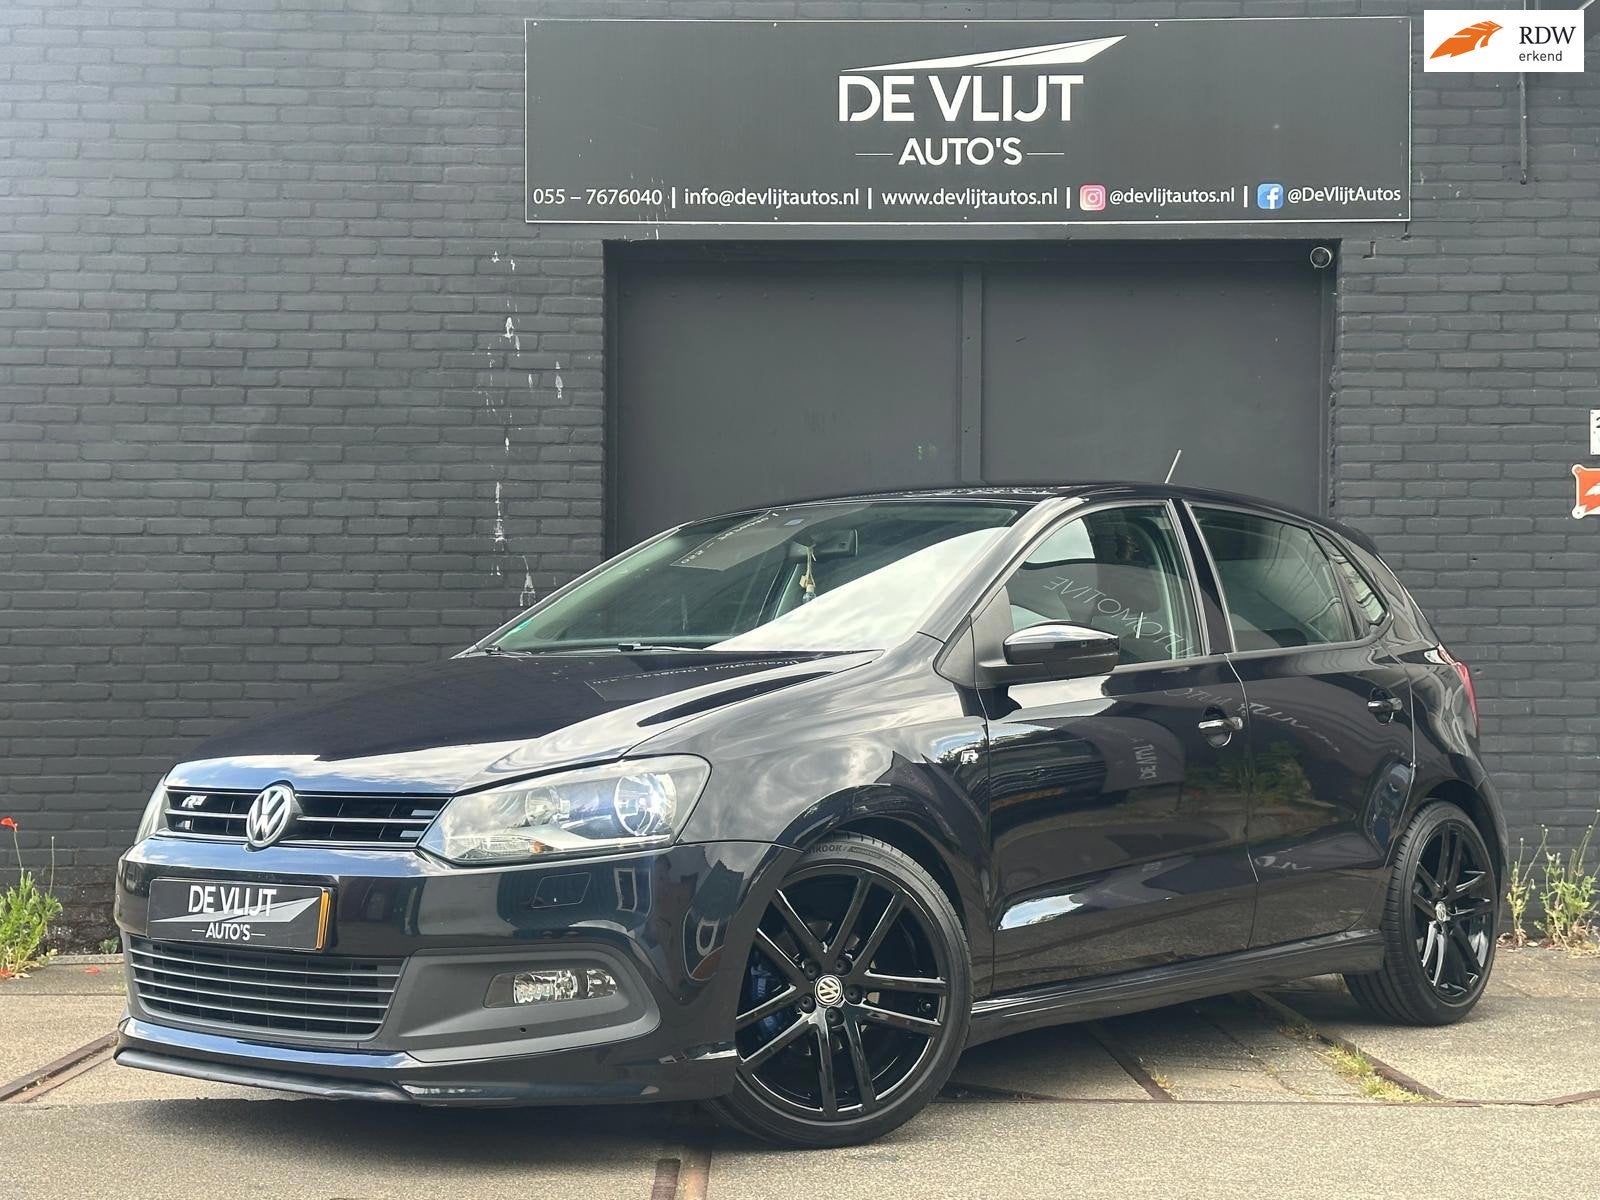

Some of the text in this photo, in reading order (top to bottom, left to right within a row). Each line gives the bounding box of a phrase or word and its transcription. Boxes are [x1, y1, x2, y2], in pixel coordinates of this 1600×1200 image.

[838, 74, 1084, 123] DE VLIJT
[898, 136, 1023, 166] AUTO'S
[533, 188, 566, 205] 055
[585, 188, 663, 206] 7676040
[684, 187, 859, 209] info@devlijtautos.nl
[881, 187, 1058, 209] www.devlijtautos.nl
[1109, 186, 1235, 207] @devlijtautos.nl
[1287, 185, 1401, 205] @DeVlijtAutos
[188, 884, 278, 917] DE VLIJT
[205, 921, 251, 941] AUTO'S
